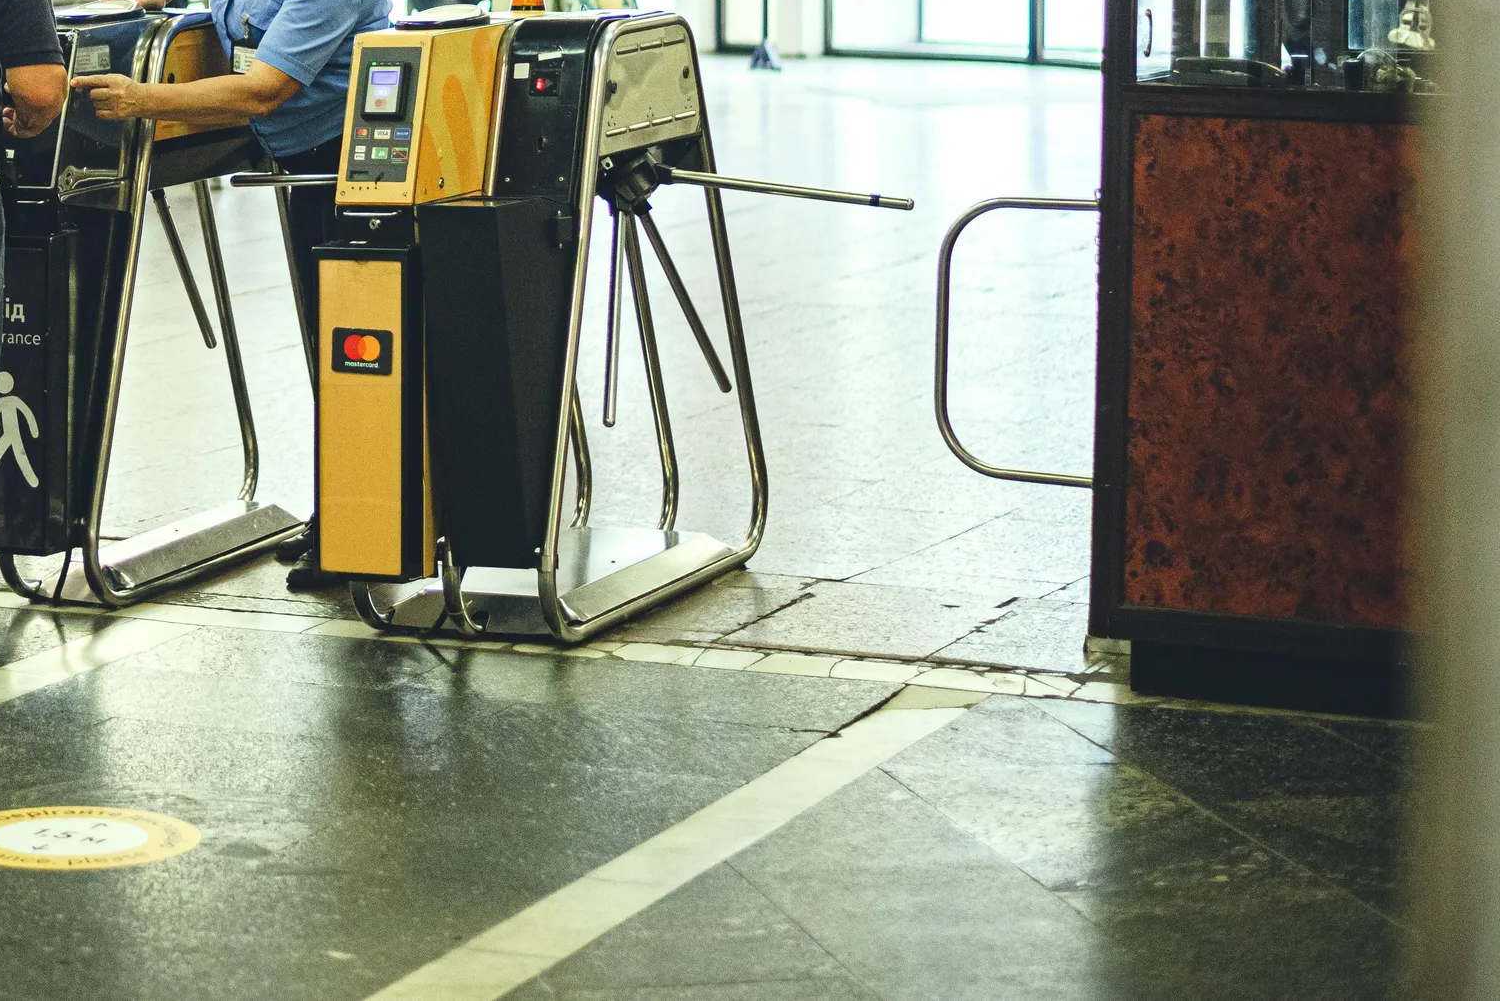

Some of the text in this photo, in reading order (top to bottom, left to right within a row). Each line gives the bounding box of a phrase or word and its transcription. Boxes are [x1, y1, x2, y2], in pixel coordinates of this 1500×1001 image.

[4, 297, 25, 323] ід
[1, 332, 41, 345] rance
[344, 361, 380, 369] mastercard
